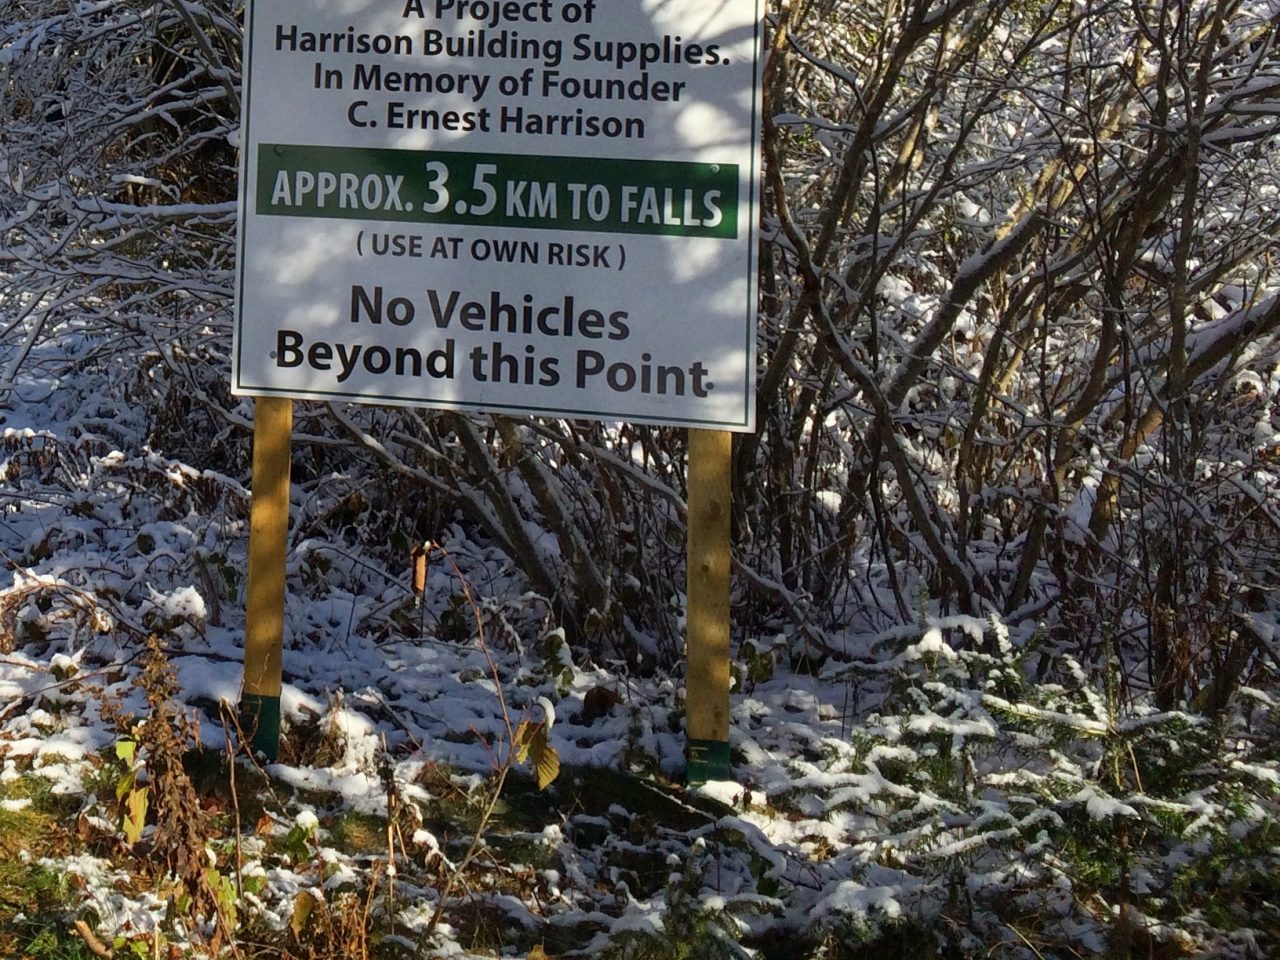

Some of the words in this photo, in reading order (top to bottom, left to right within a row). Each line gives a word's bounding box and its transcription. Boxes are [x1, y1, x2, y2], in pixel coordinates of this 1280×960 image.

[276, 25, 412, 55] Harrison
[423, 29, 561, 67] Building
[314, 63, 343, 89] In
[353, 65, 489, 101] Memory
[499, 68, 533, 96] of
[542, 71, 685, 101] Founder
[348, 101, 377, 128] C.
[388, 103, 490, 133] Ernest
[500, 107, 645, 138] Harrison
[271, 170, 413, 212] APPROX.
[423, 161, 498, 216] 3.5
[506, 181, 557, 219] KM
[568, 183, 610, 222] TO
[621, 186, 722, 227] FALLS
[430, 237, 463, 260] AT
[471, 239, 539, 264] OWN
[350, 285, 415, 328] No
[427, 289, 630, 341] Vehicles
[276, 330, 455, 382] Beyond
[470, 343, 559, 387] this
[577, 349, 708, 398] Point
